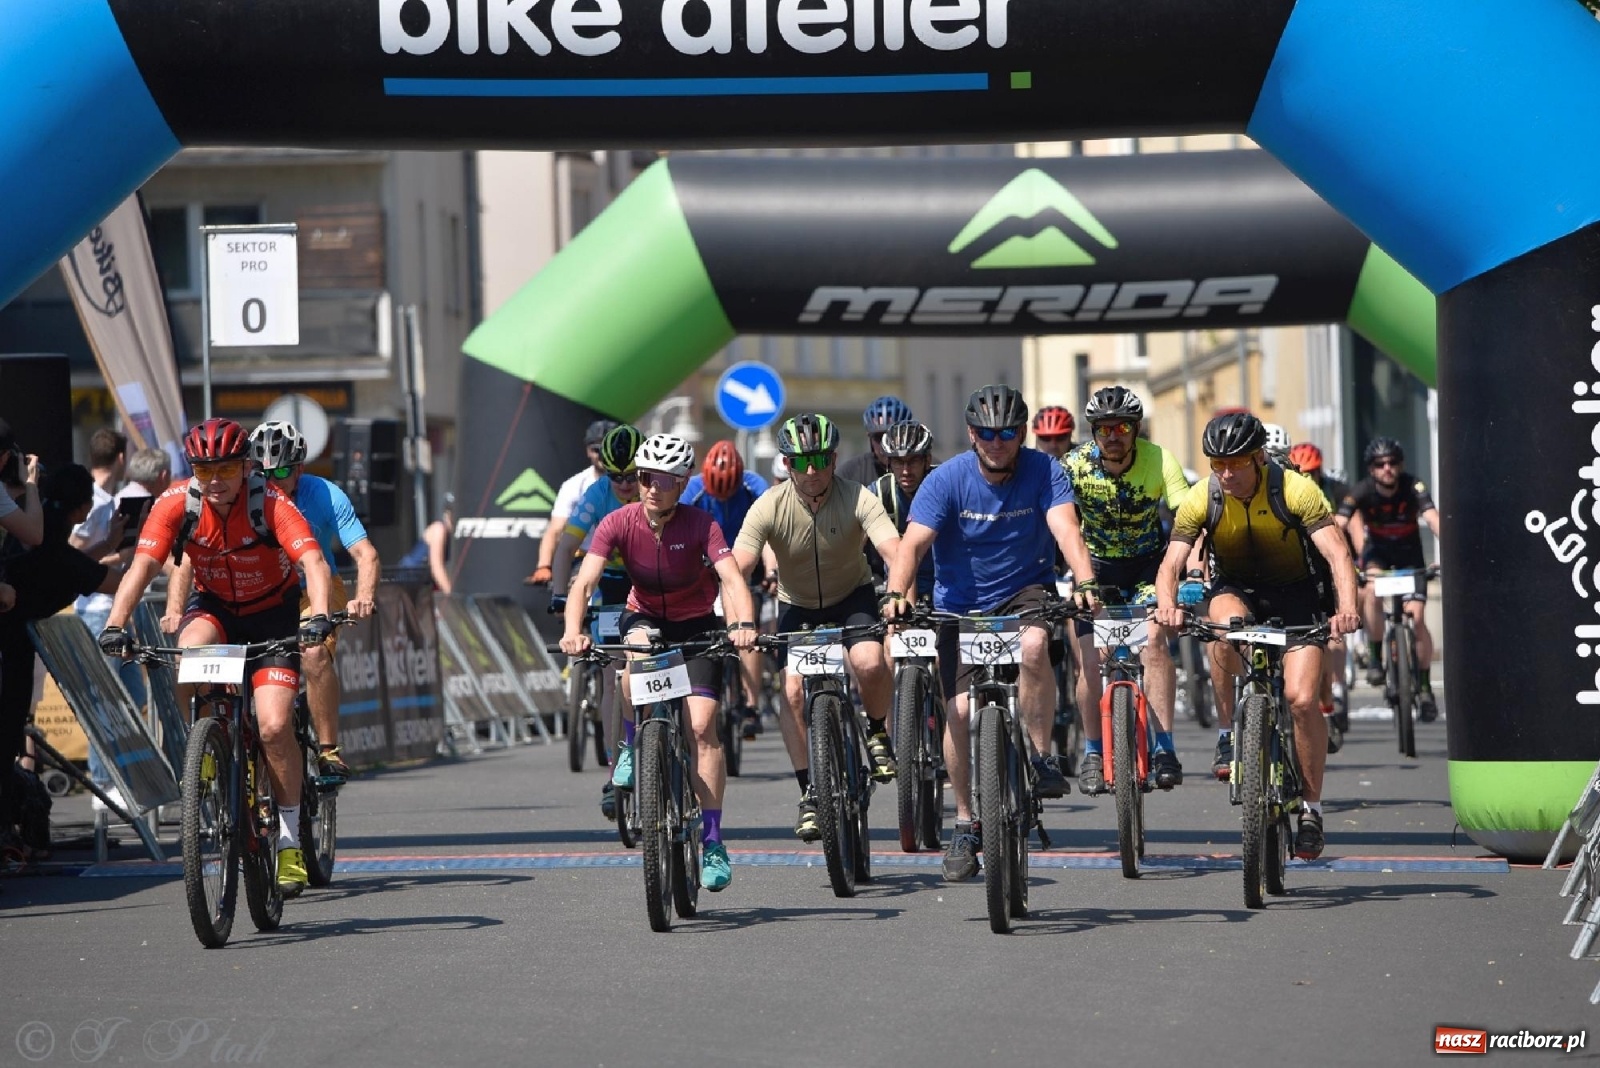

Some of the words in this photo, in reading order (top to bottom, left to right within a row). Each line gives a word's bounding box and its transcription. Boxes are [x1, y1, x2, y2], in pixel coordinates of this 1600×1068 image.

[227, 241, 277, 254] SEKTOR
[241, 260, 268, 272] PRO
[798, 275, 1280, 325] MERIDA
[242, 297, 267, 334] 0
[905, 636, 927, 647] 130
[977, 641, 1003, 654] 139
[203, 664, 221, 674] 111
[268, 670, 296, 685] Nice
[646, 676, 672, 693] 184
